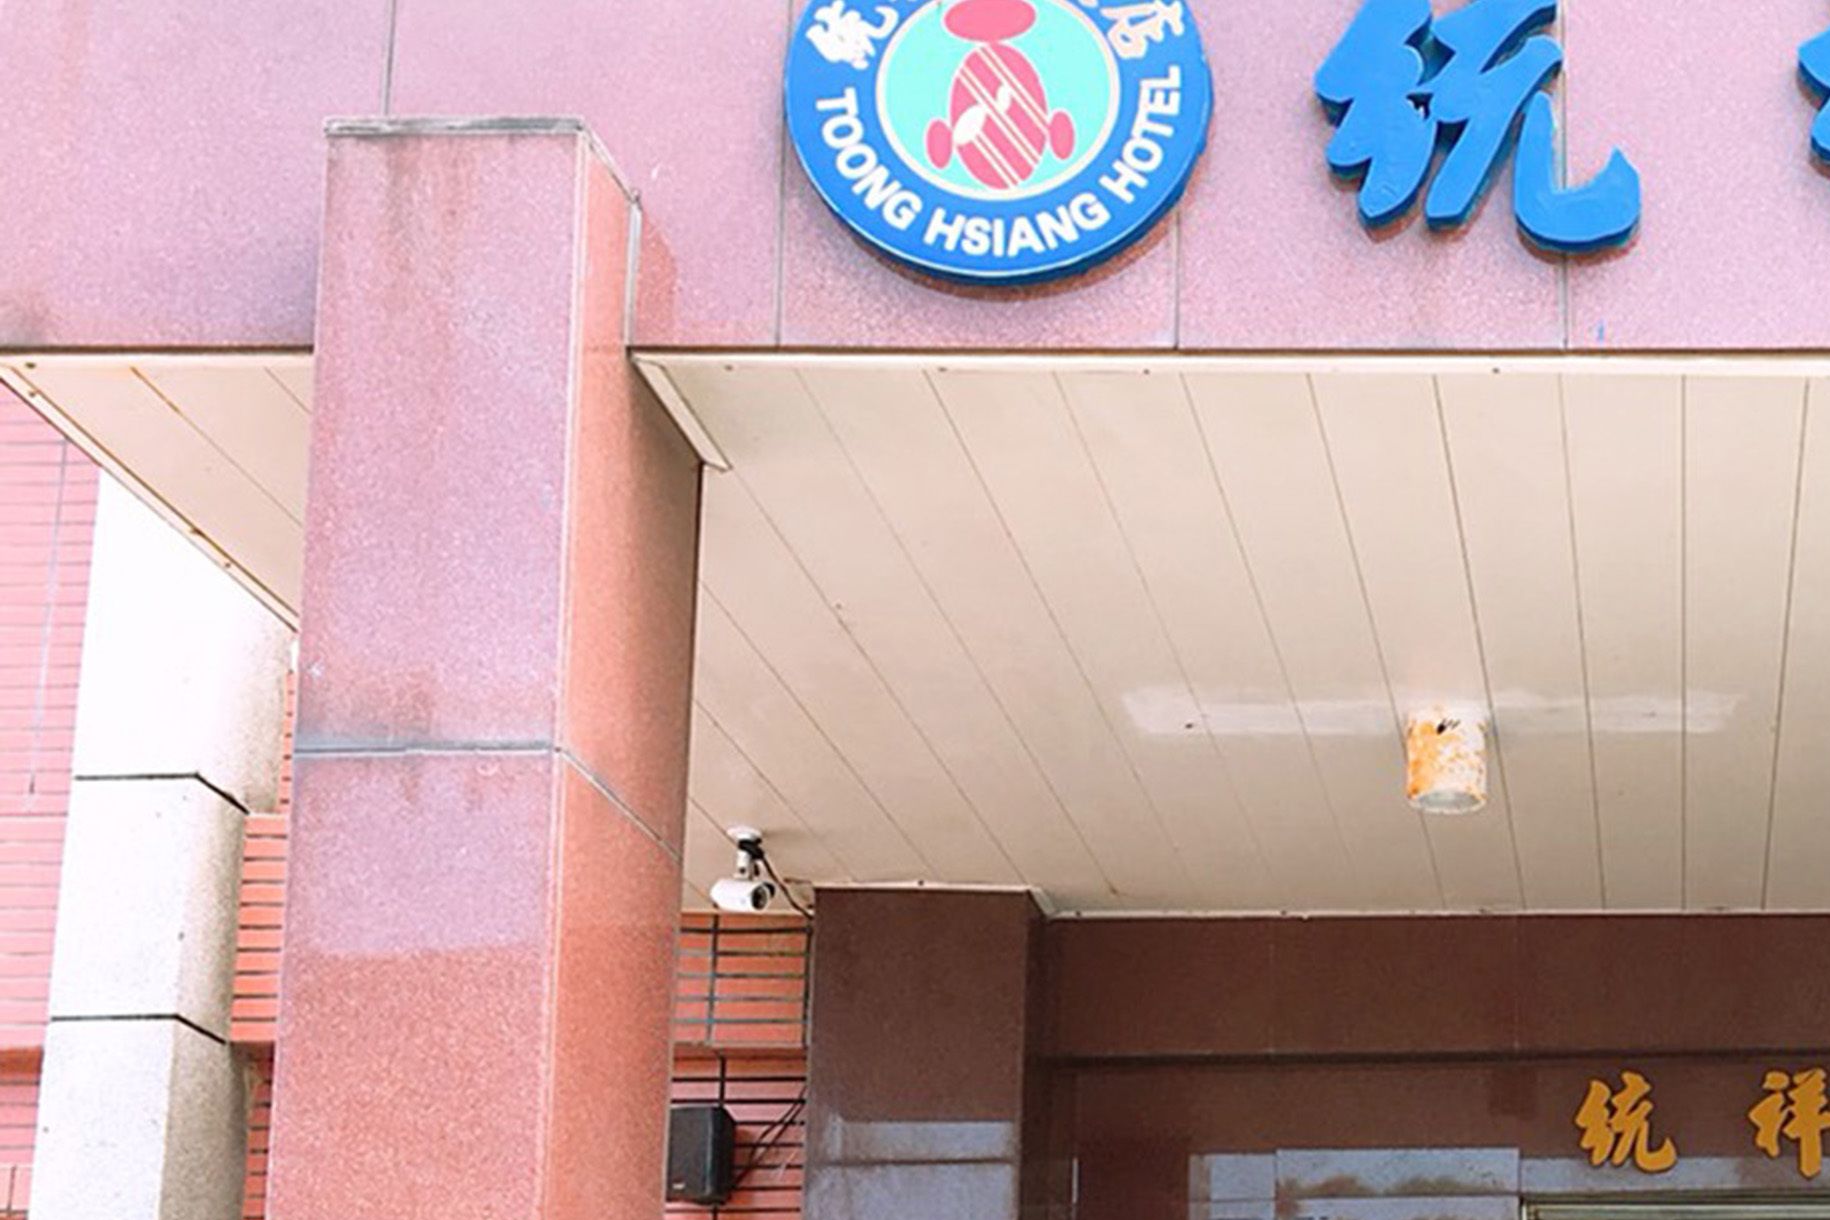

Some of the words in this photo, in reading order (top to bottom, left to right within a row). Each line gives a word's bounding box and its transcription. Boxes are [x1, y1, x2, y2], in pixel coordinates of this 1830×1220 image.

[815, 86, 924, 232] TOONG
[922, 192, 1112, 259] HSIANG
[1099, 64, 1182, 205] HOTEL
